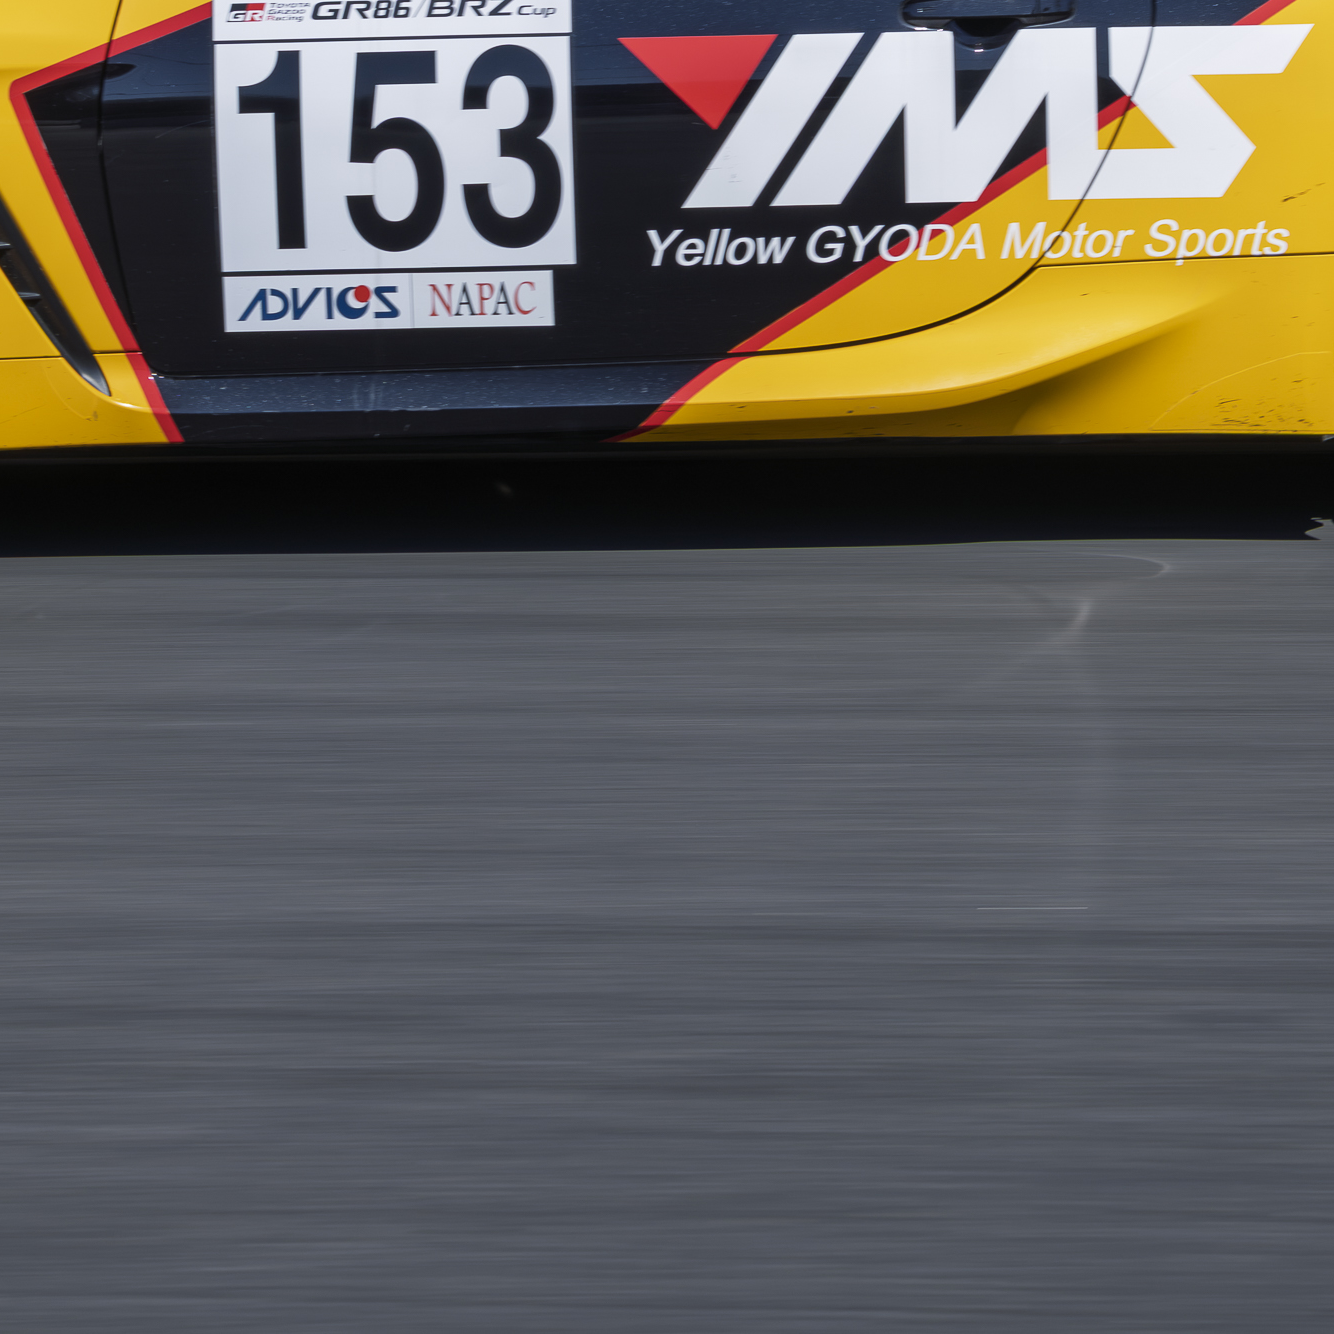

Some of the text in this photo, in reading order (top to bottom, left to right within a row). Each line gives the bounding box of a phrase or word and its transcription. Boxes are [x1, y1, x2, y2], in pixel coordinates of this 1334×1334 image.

[228, 10, 265, 23] GR
[518, 4, 557, 19] Cup
[237, 44, 563, 253] 153
[646, 218, 1290, 267] Yellow GYODA Motor Sports
[238, 284, 401, 322] ADVICS
[428, 281, 537, 317] NAPAC
